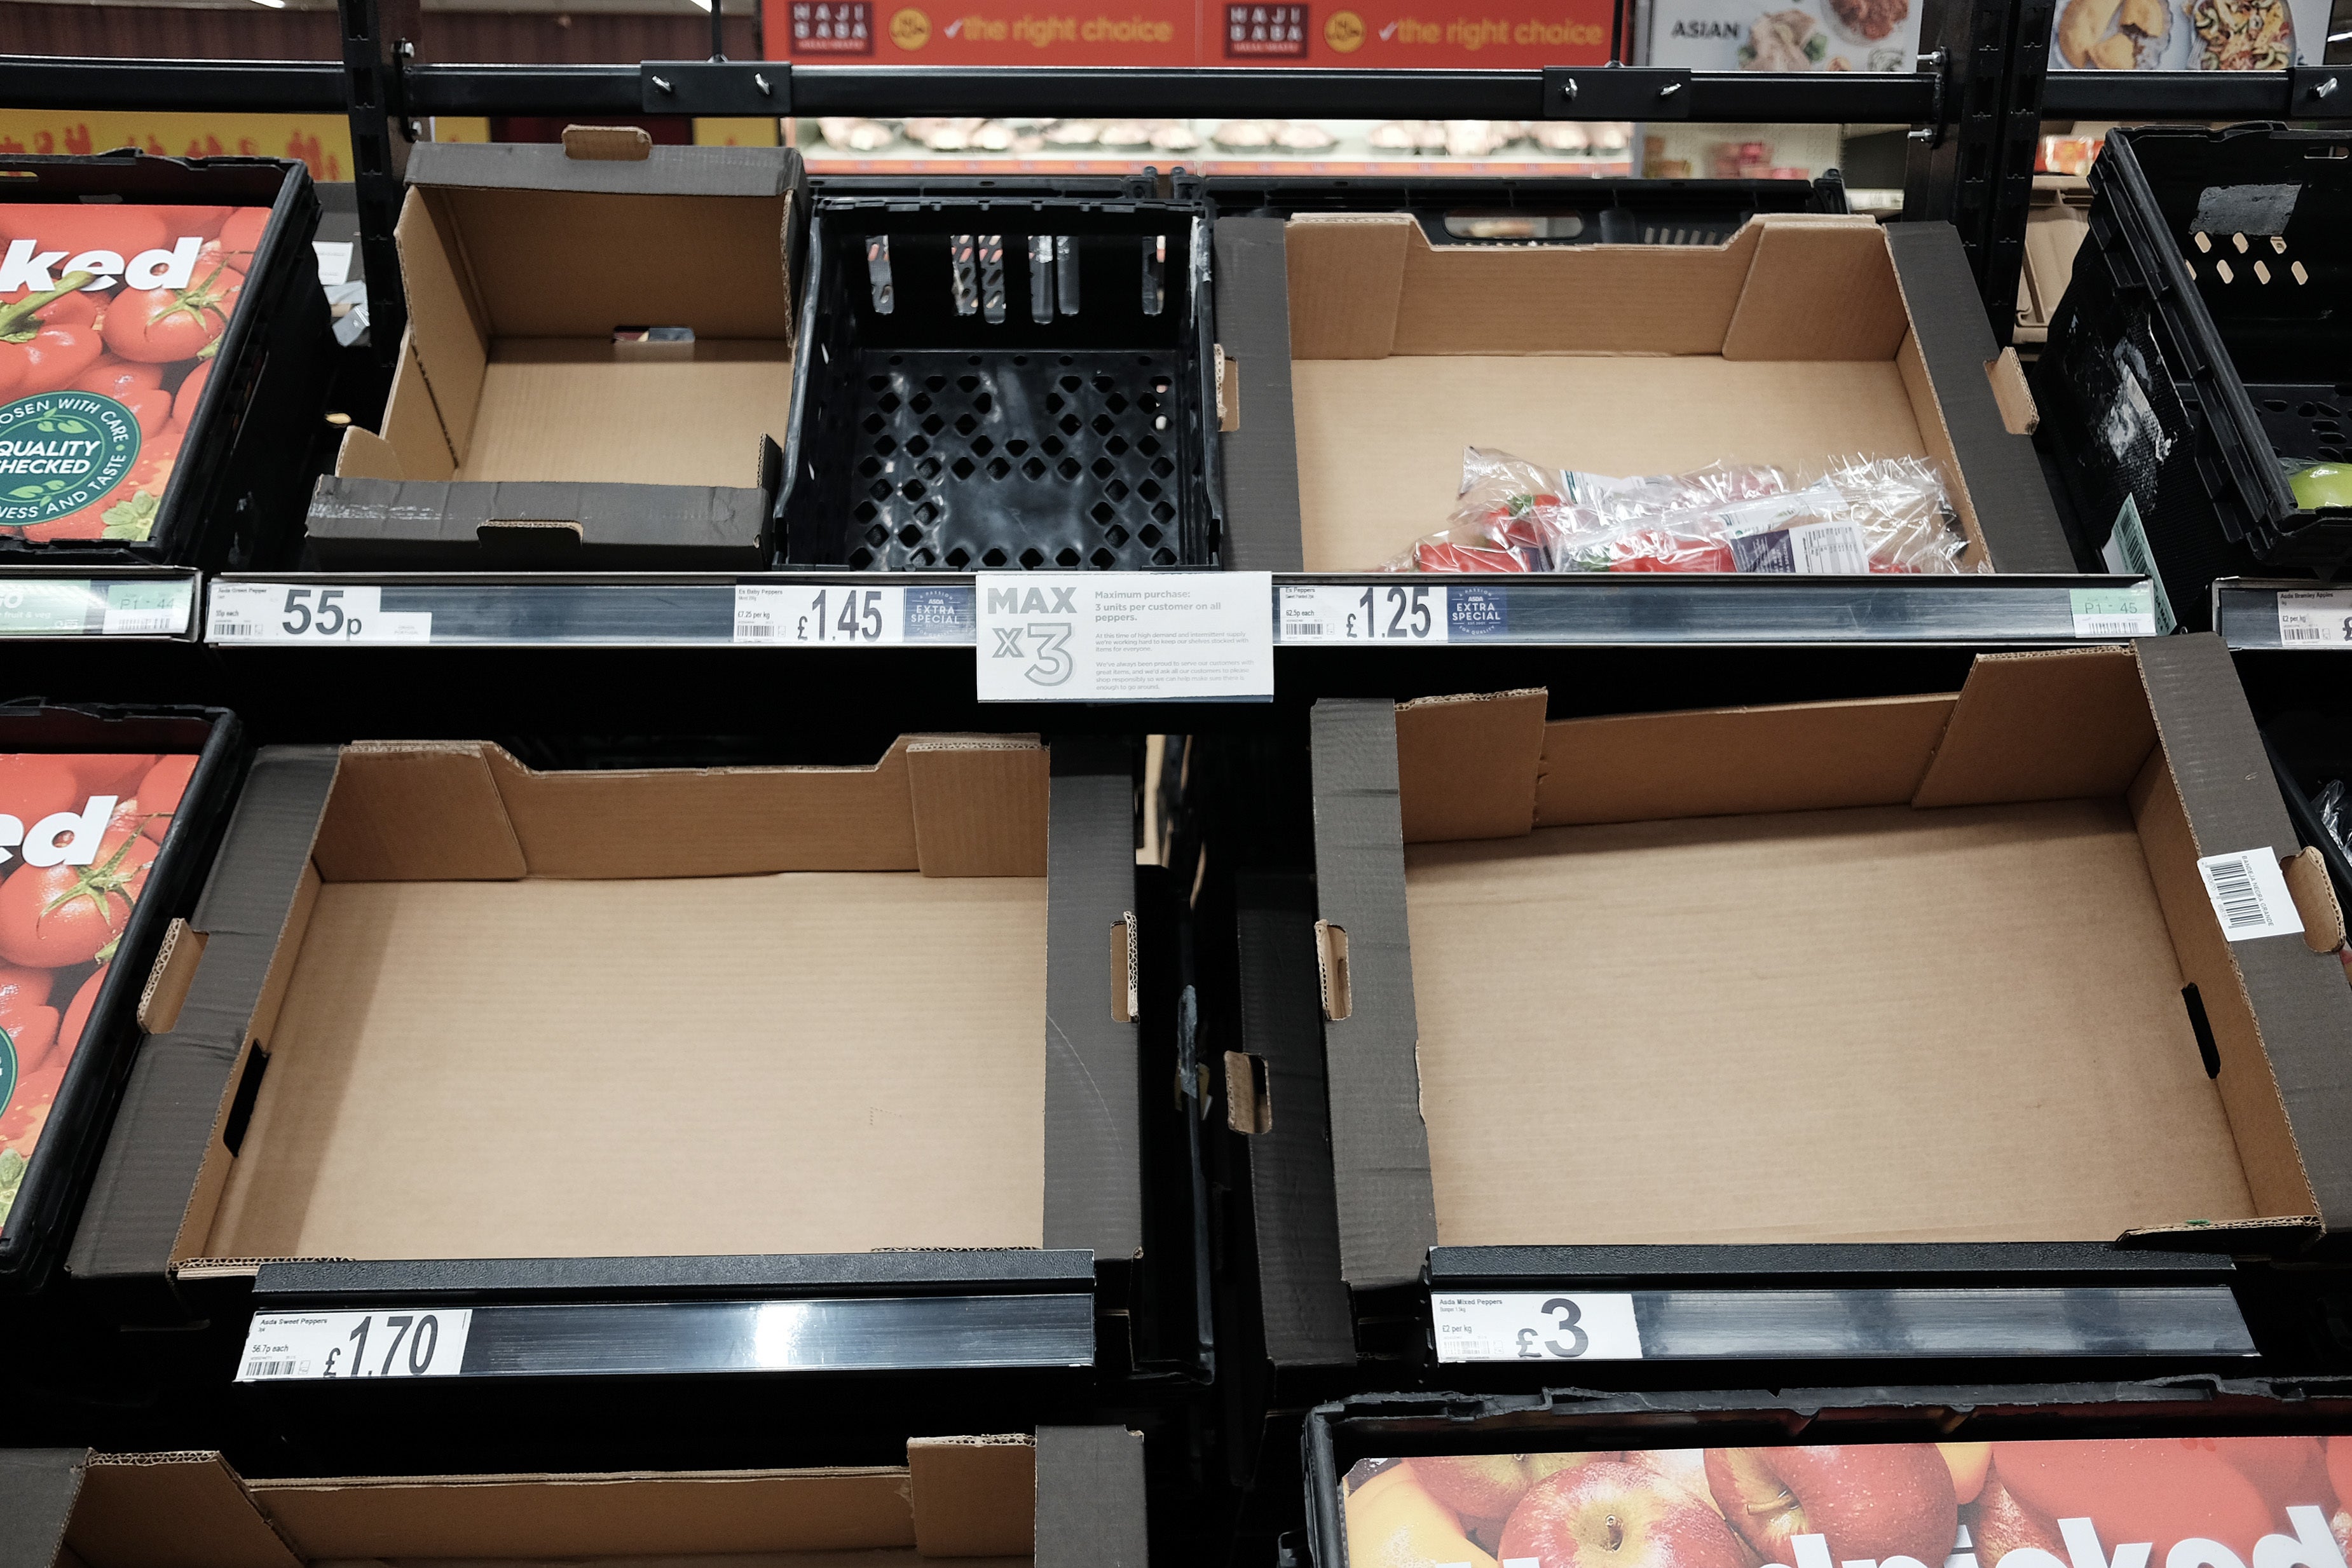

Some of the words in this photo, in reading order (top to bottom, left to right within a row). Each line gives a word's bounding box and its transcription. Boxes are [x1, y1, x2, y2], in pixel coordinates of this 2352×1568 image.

[1230, 6, 1300, 24] HAJI
[1082, 15, 1174, 42] choice
[1230, 24, 1302, 41] BABA
[1399, 18, 1441, 44] the
[1447, 17, 1509, 51] right
[1514, 17, 1604, 45] choice
[1671, 20, 1739, 37] ASIAN
[58, 399, 100, 414] WITH
[100, 411, 128, 442] CARE
[0, 440, 101, 457] QUALITY
[0, 459, 90, 474] HECKED
[46, 491, 88, 514] AND
[88, 454, 126, 490] TASTE
[1144, 590, 1191, 599] purchase:
[1465, 588, 1491, 596] PASSION
[157, 598, 174, 609] 44
[987, 587, 1077, 615] MAX
[1456, 603, 1495, 611] EXTRA
[2085, 603, 2102, 613] P1
[2121, 603, 2137, 613] 45
[282, 589, 362, 641] 55p
[763, 611, 770, 620] kg
[797, 589, 882, 643] £1.45
[916, 605, 955, 615] EXTRA
[1095, 614, 1137, 622] peppers.
[1346, 587, 1431, 638] £1.25
[1452, 612, 1500, 620] SPECIAL
[911, 614, 959, 624] SPECIAL
[1472, 625, 1494, 635] QUALITY
[992, 622, 1074, 687] x3
[2242, 856, 2255, 881] BANDEJA
[2253, 882, 2263, 902] NEGRA
[2260, 903, 2274, 926] GRANDE
[1464, 1325, 1472, 1333] kg
[1515, 1298, 1589, 1358] £3
[252, 1345, 270, 1354] 56.7p
[323, 1314, 438, 1378] £1.70
